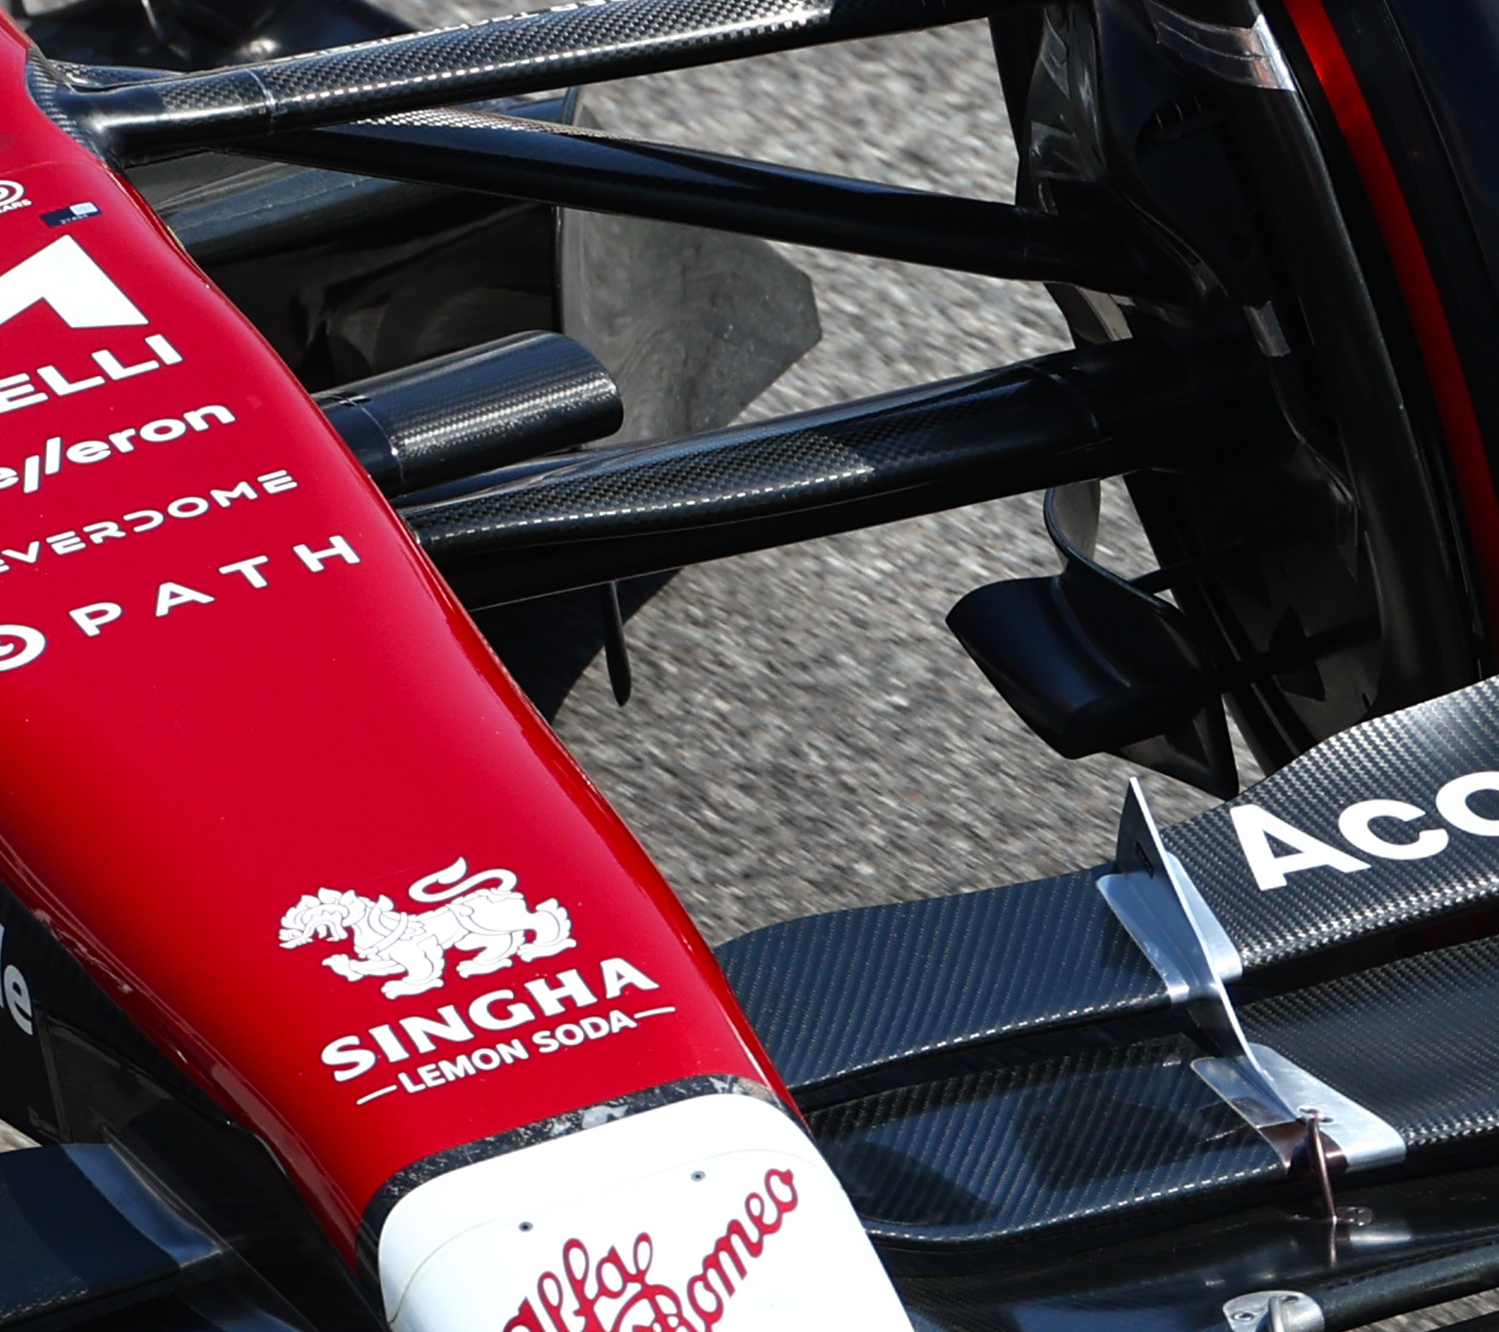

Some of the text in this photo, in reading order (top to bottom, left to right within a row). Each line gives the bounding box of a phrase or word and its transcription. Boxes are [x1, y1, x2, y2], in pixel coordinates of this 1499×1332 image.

[68, 533, 364, 638] PATH
[319, 956, 661, 1083] SINGHA
[395, 1008, 640, 1095] LEMON SODA
